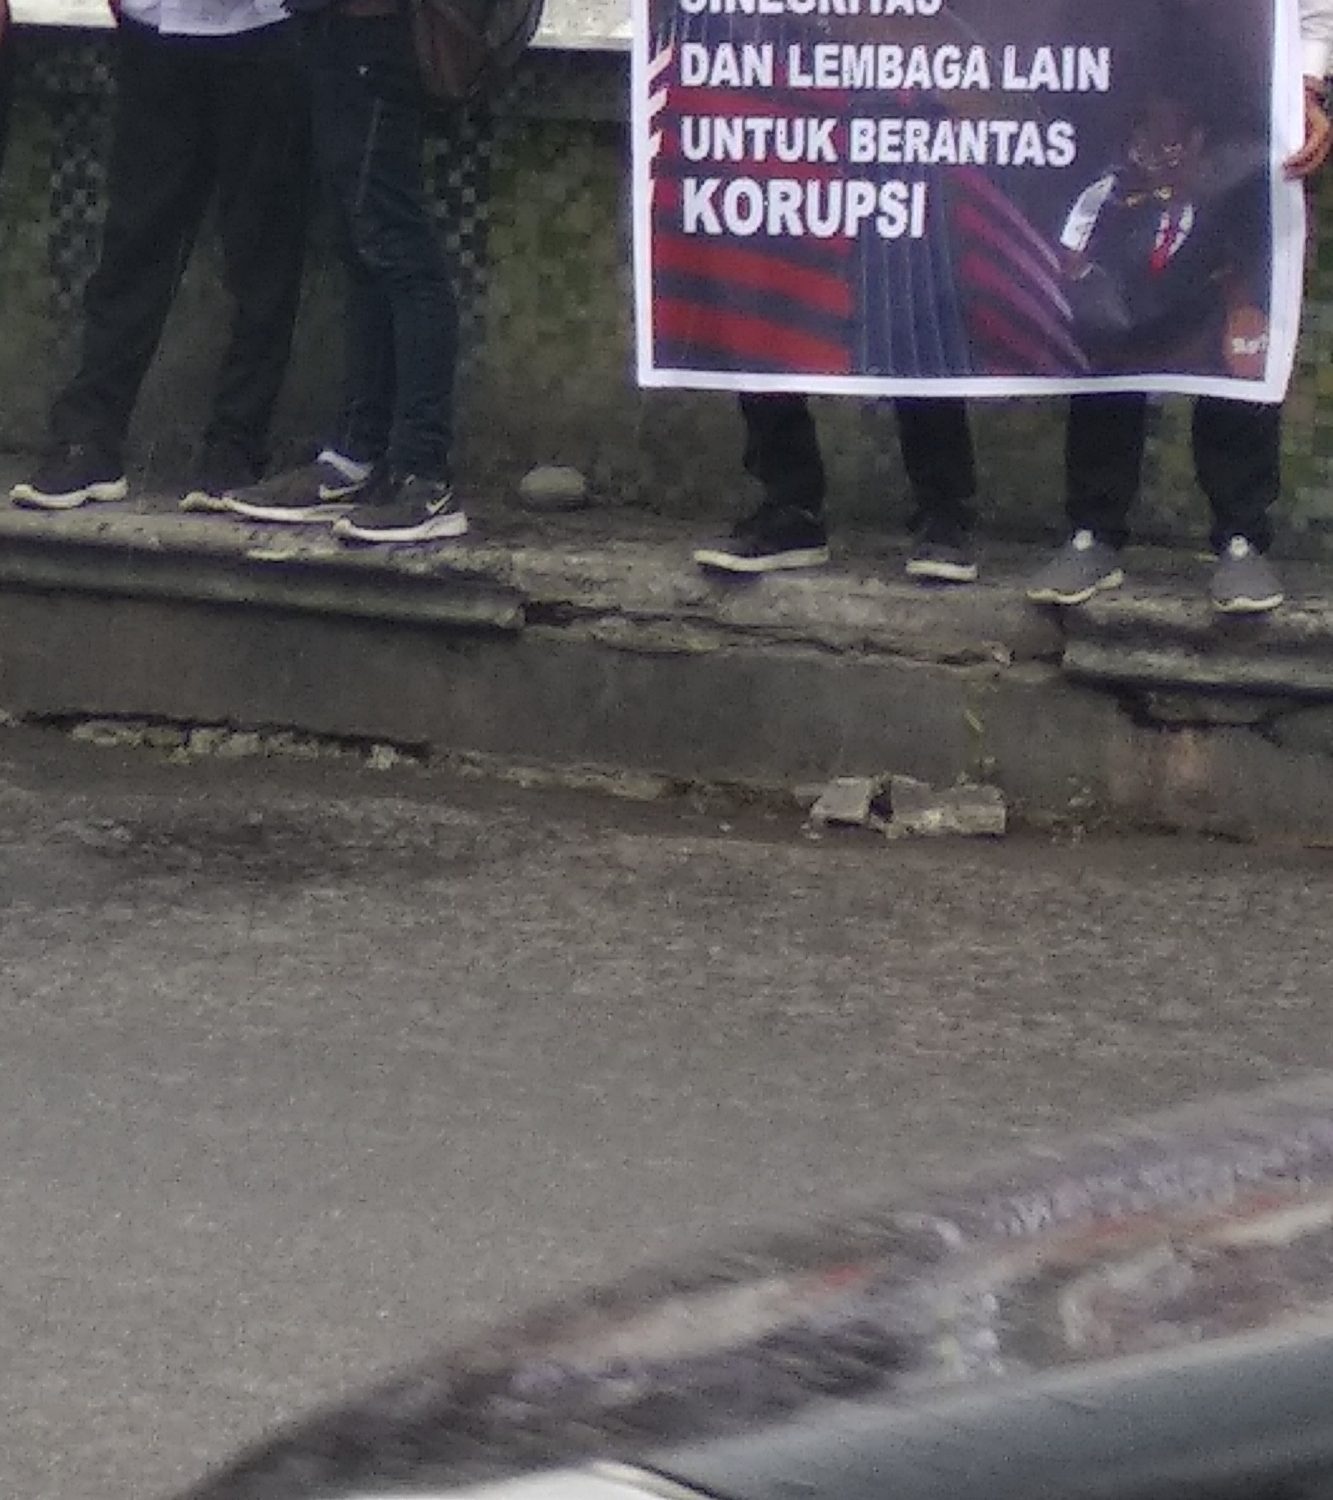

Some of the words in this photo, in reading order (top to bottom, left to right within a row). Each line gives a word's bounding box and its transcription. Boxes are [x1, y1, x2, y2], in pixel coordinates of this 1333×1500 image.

[680, 44, 773, 88] DAN
[787, 46, 991, 91] LEMBAGA
[1001, 46, 1110, 92] LAIN
[681, 117, 837, 162] UNTUK
[848, 119, 1077, 167] BERANTAS
[681, 178, 927, 239] KORUPSI
